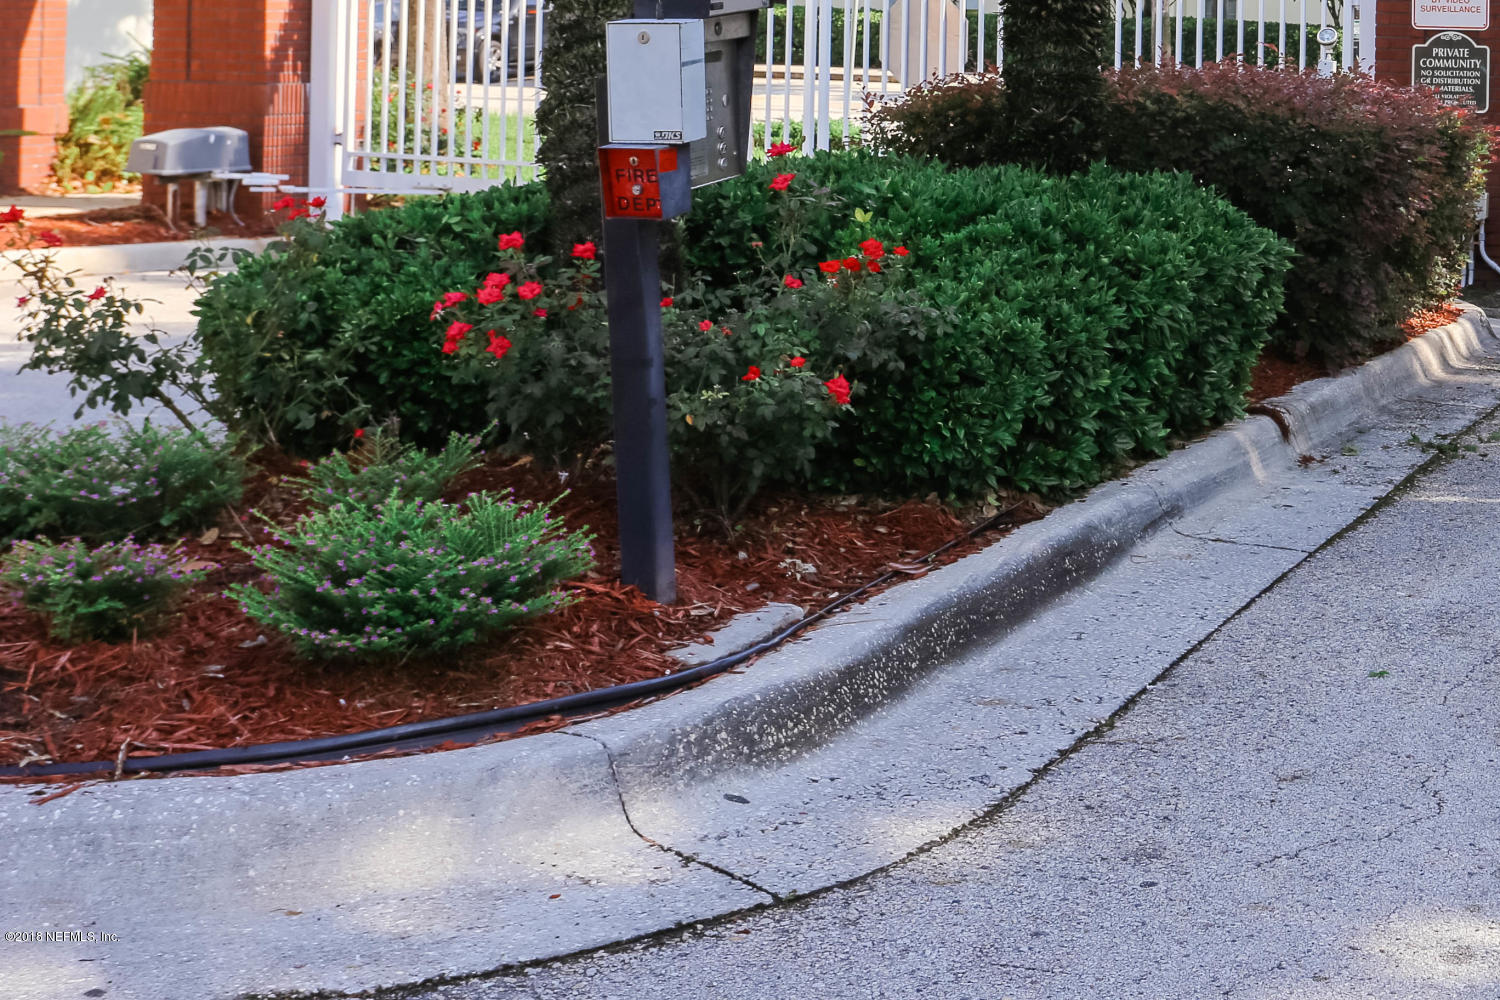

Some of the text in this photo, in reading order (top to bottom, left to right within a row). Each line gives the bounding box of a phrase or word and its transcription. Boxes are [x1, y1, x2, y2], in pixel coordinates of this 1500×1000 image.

[1420, 5, 1481, 13] SURVEILLANCE
[1432, 47, 1470, 58] PRIVATE
[1420, 58, 1481, 69] COMMUNITY
[1420, 69, 1480, 78] NO SOLICITATION
[615, 168, 658, 184] FIRE
